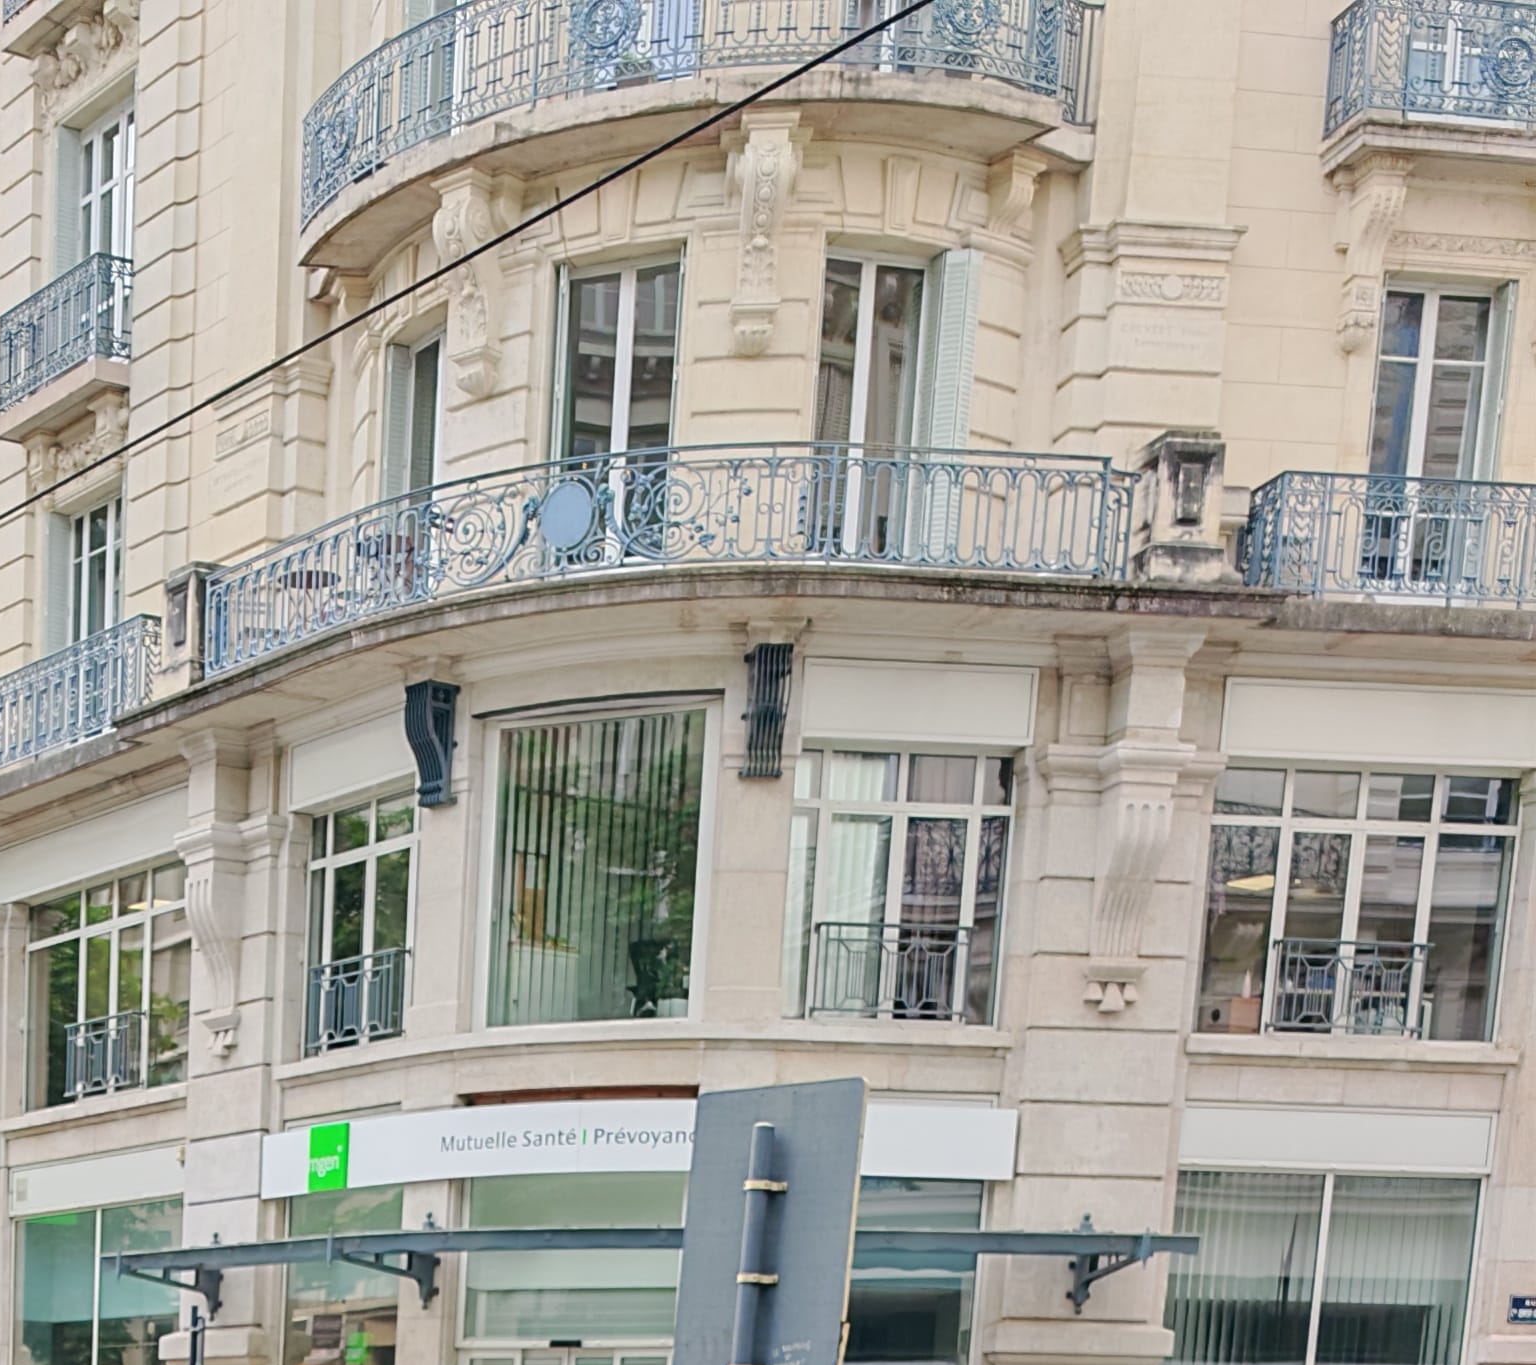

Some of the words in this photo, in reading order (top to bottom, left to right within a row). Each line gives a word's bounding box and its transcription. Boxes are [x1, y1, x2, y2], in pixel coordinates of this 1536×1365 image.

[440, 1131, 517, 1153] Mutuelle
[521, 1128, 576, 1148] Santé
[310, 1154, 340, 1178] mgen
